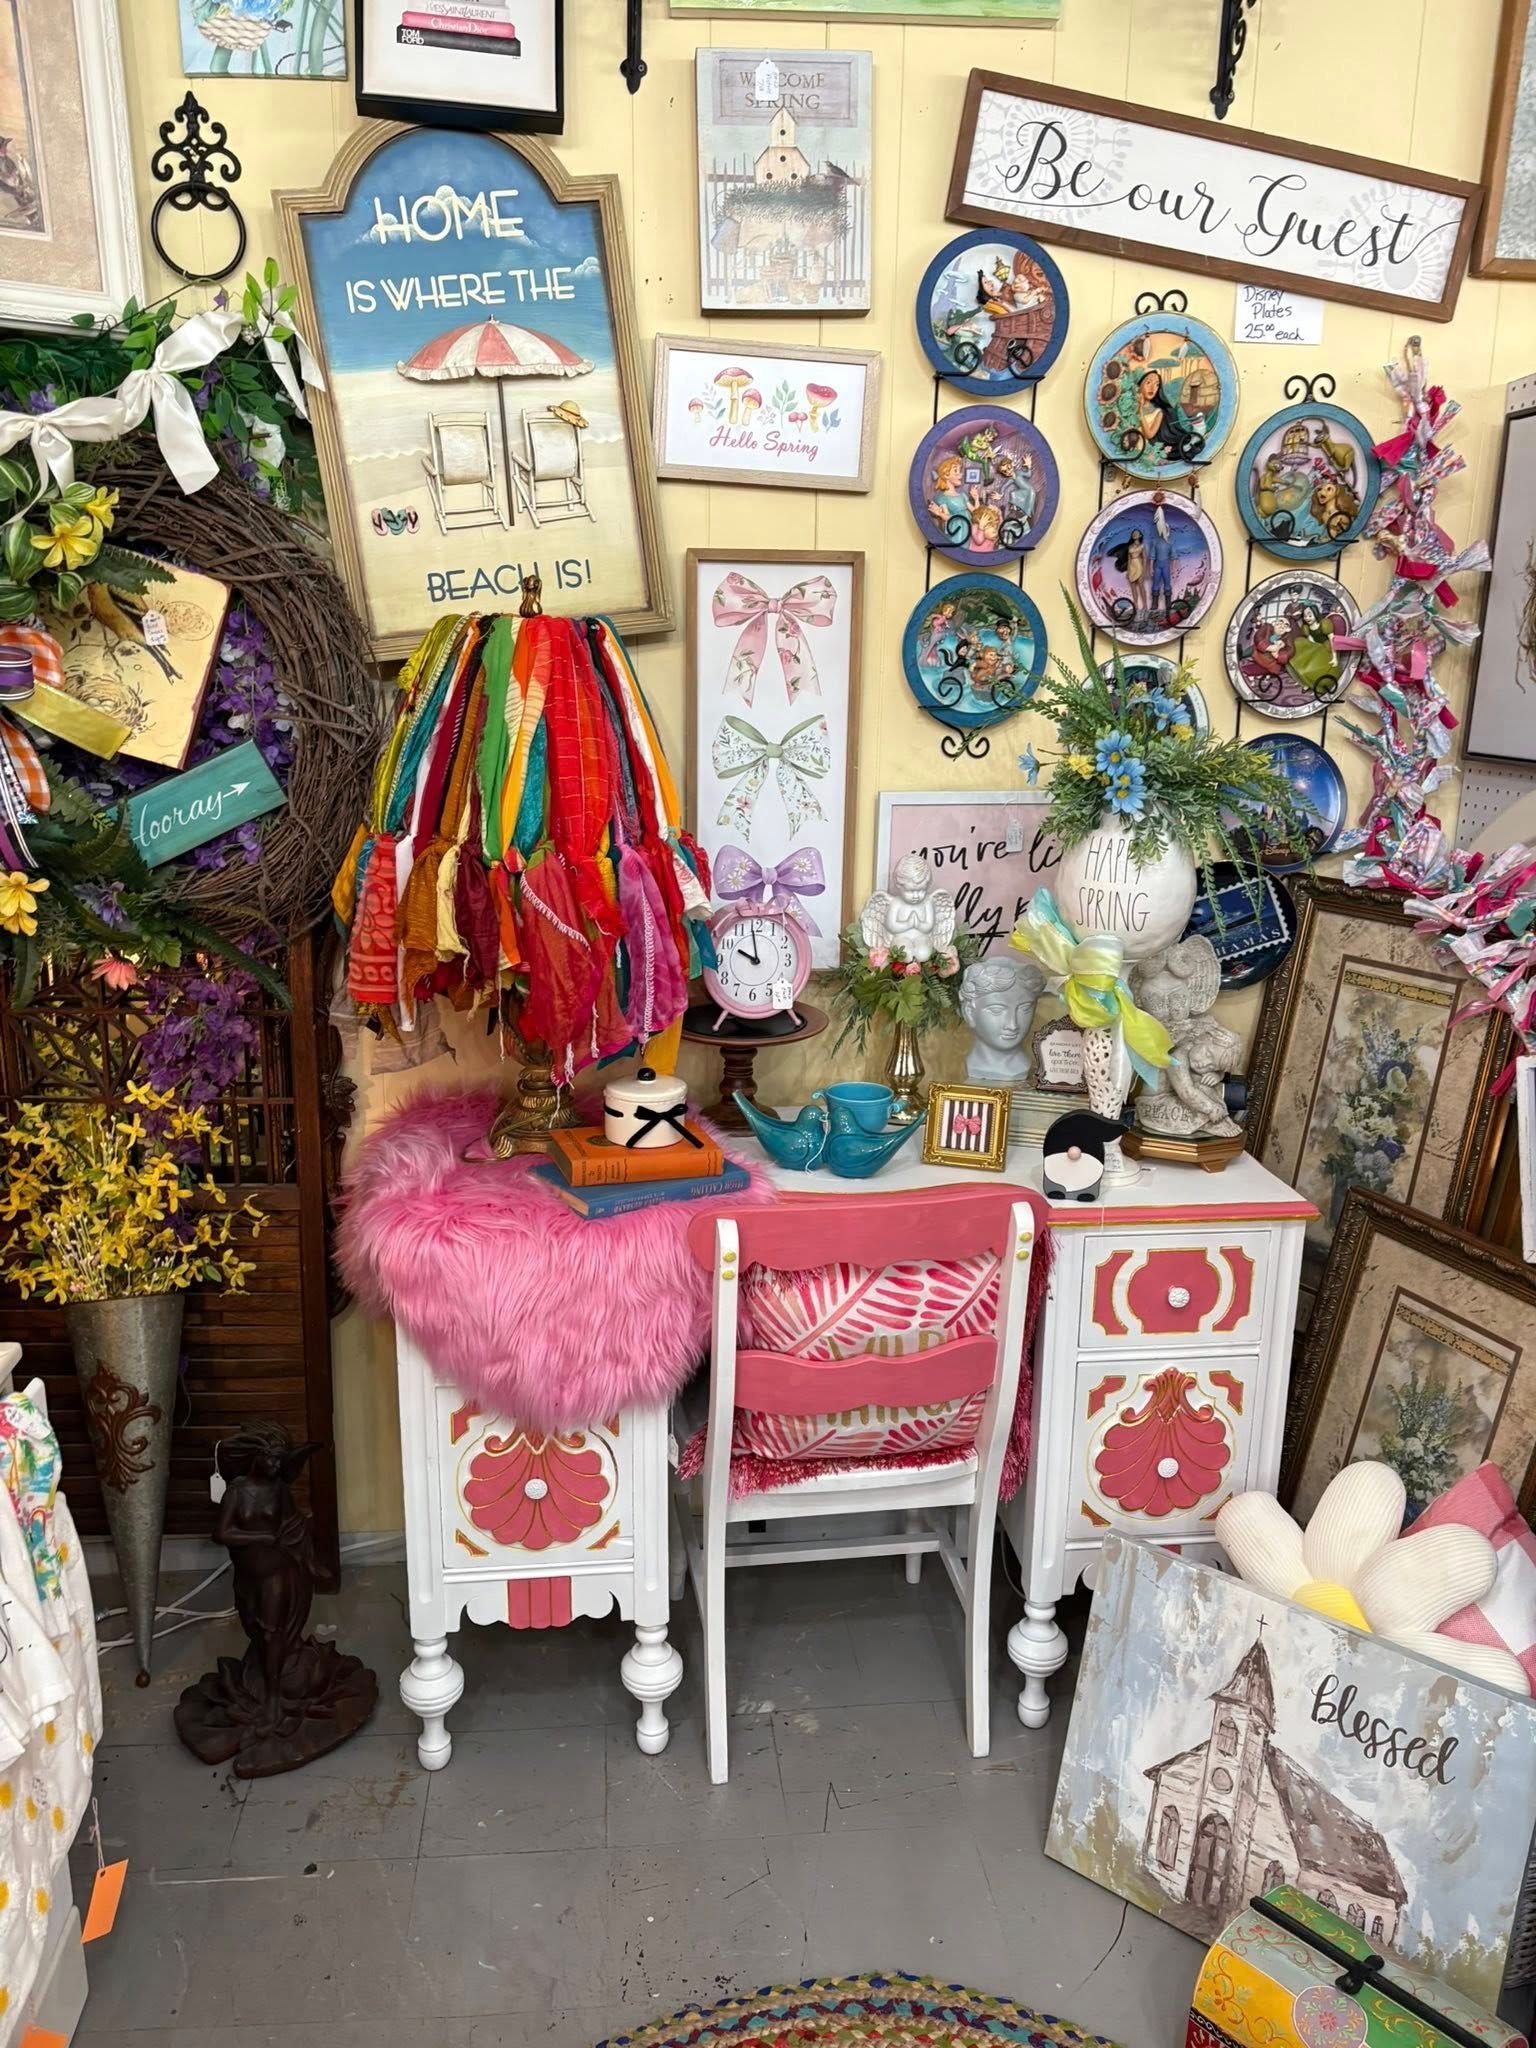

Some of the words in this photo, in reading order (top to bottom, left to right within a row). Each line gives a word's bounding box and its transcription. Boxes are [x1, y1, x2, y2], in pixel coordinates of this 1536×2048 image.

[401, 28, 420, 38] TOM
[401, 36, 425, 45] FORD
[995, 121, 1105, 200] Be
[1112, 181, 1231, 234] our
[1234, 174, 1461, 267] Guest
[374, 188, 525, 245] HOME
[345, 279, 377, 314] IS
[379, 271, 506, 312] WHERE
[508, 266, 576, 301] THE
[1243, 285, 1285, 306] Disney
[1251, 302, 1293, 320] Plates
[1275, 327, 1305, 341] each
[709, 425, 758, 449] Hello
[763, 430, 819, 462] Spring
[427, 561, 541, 603] BEACH
[555, 558, 592, 590] IS!
[1076, 886, 1151, 932] SPRING
[734, 923, 745, 937] 11
[771, 922, 776, 937] 1
[721, 938, 734, 950] 10
[780, 935, 788, 950] 2
[784, 953, 792, 968] 3
[720, 971, 729, 986] 8
[733, 983, 741, 997] 7
[748, 988, 757, 1002] 6
[765, 983, 773, 997] 5
[1144, 1104, 1190, 1122] PEACE
[1310, 1674, 1459, 1785] blessed
